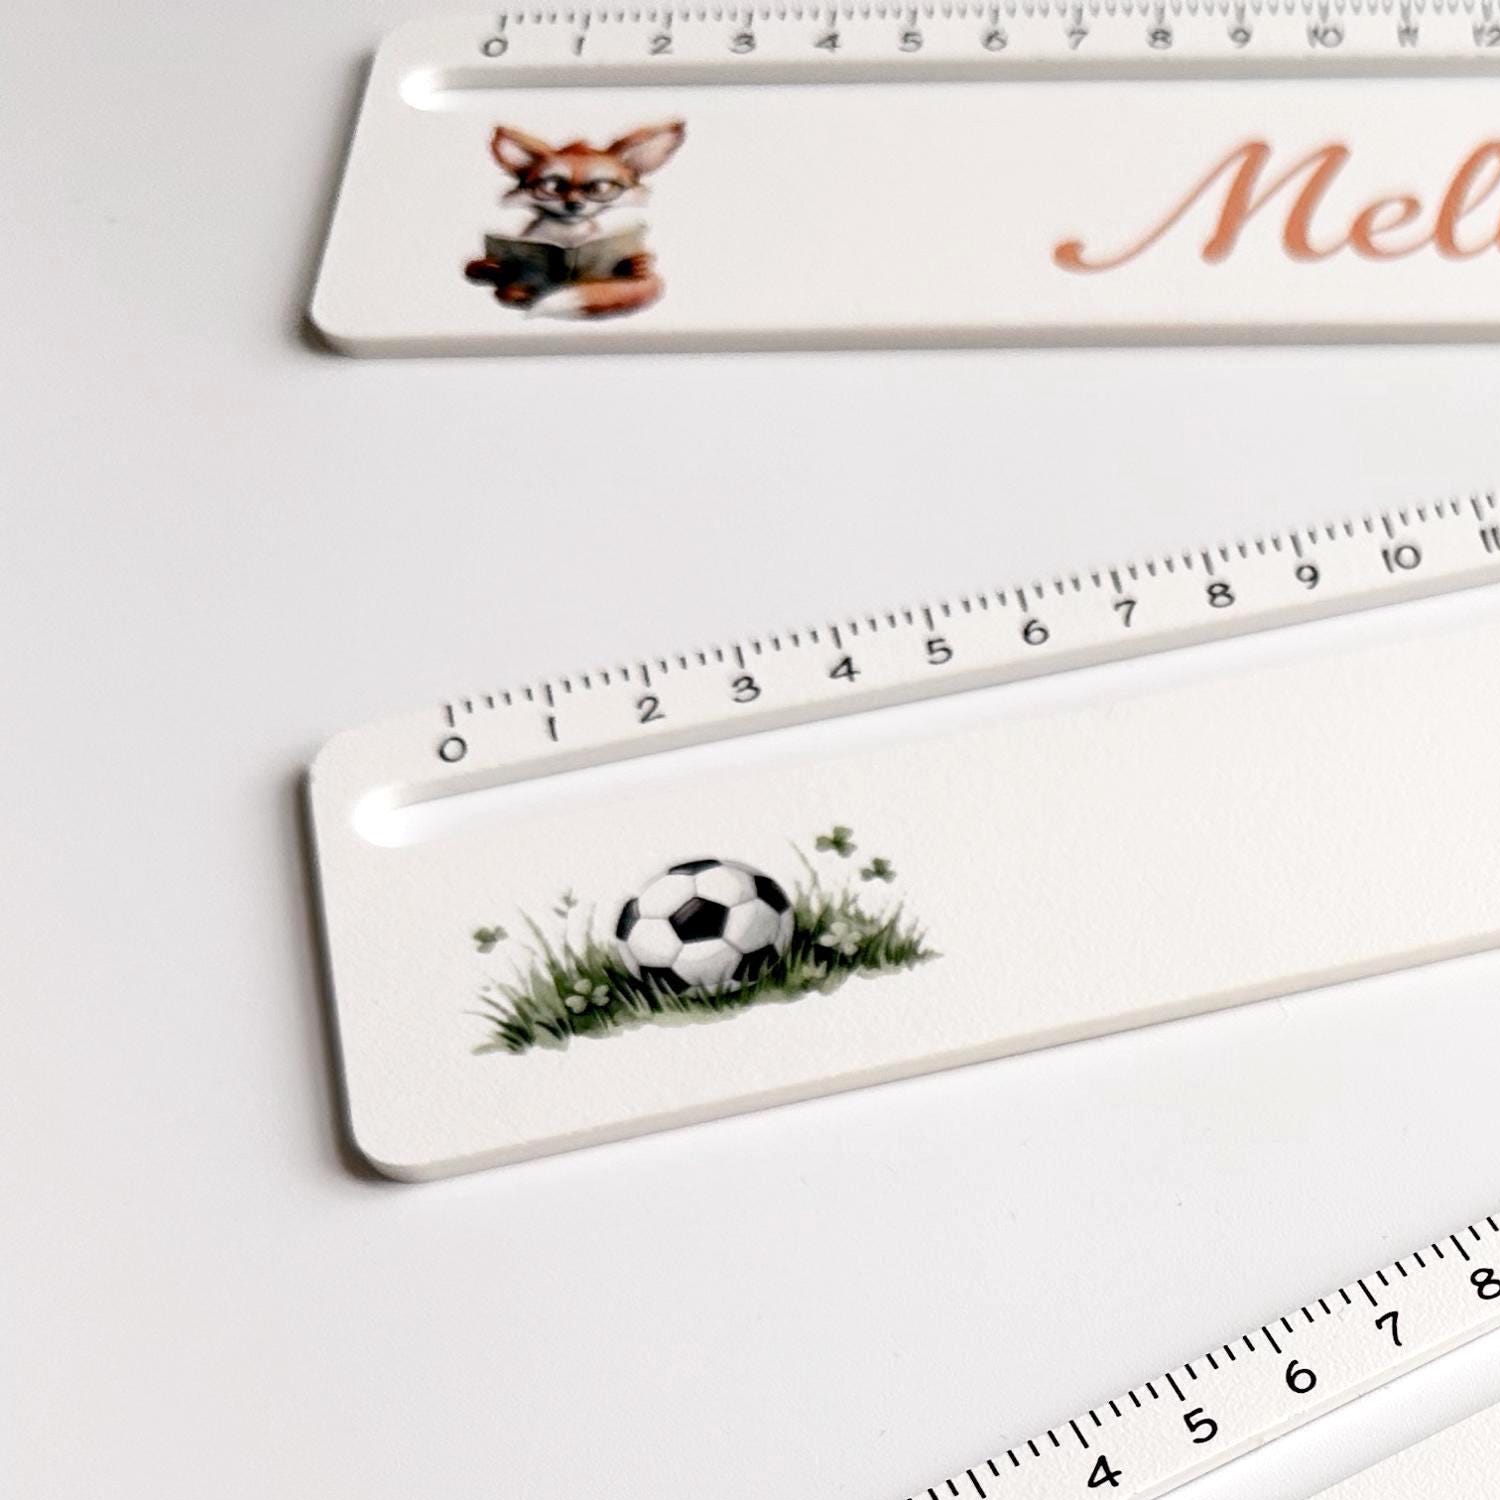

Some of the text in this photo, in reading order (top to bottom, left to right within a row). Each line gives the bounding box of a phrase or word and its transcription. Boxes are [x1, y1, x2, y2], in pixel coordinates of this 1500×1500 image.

[480, 36, 508, 57] 0
[649, 32, 674, 56] 2
[730, 30, 756, 54] 3
[814, 31, 840, 52] 4
[899, 28, 923, 52] 5
[981, 29, 1007, 51] 6
[1066, 27, 1088, 50] 7
[1149, 27, 1173, 49] 8
[1228, 26, 1251, 48] 9
[1307, 24, 1344, 48] 10
[436, 736, 467, 763] 0
[546, 716, 558, 741] 1
[636, 695, 665, 724] 2
[731, 674, 761, 703] 3
[829, 655, 861, 682] 4
[926, 637, 953, 665] 5
[1021, 618, 1050, 645] 6
[1114, 598, 1136, 627] 7
[1206, 581, 1235, 608] 8
[1295, 564, 1320, 589] 9
[1381, 544, 1421, 573] 10
[1088, 1455, 1122, 1488] 4
[1183, 1408, 1218, 1444] 5
[1286, 1360, 1317, 1393] 6
[1375, 1311, 1402, 1347] 7
